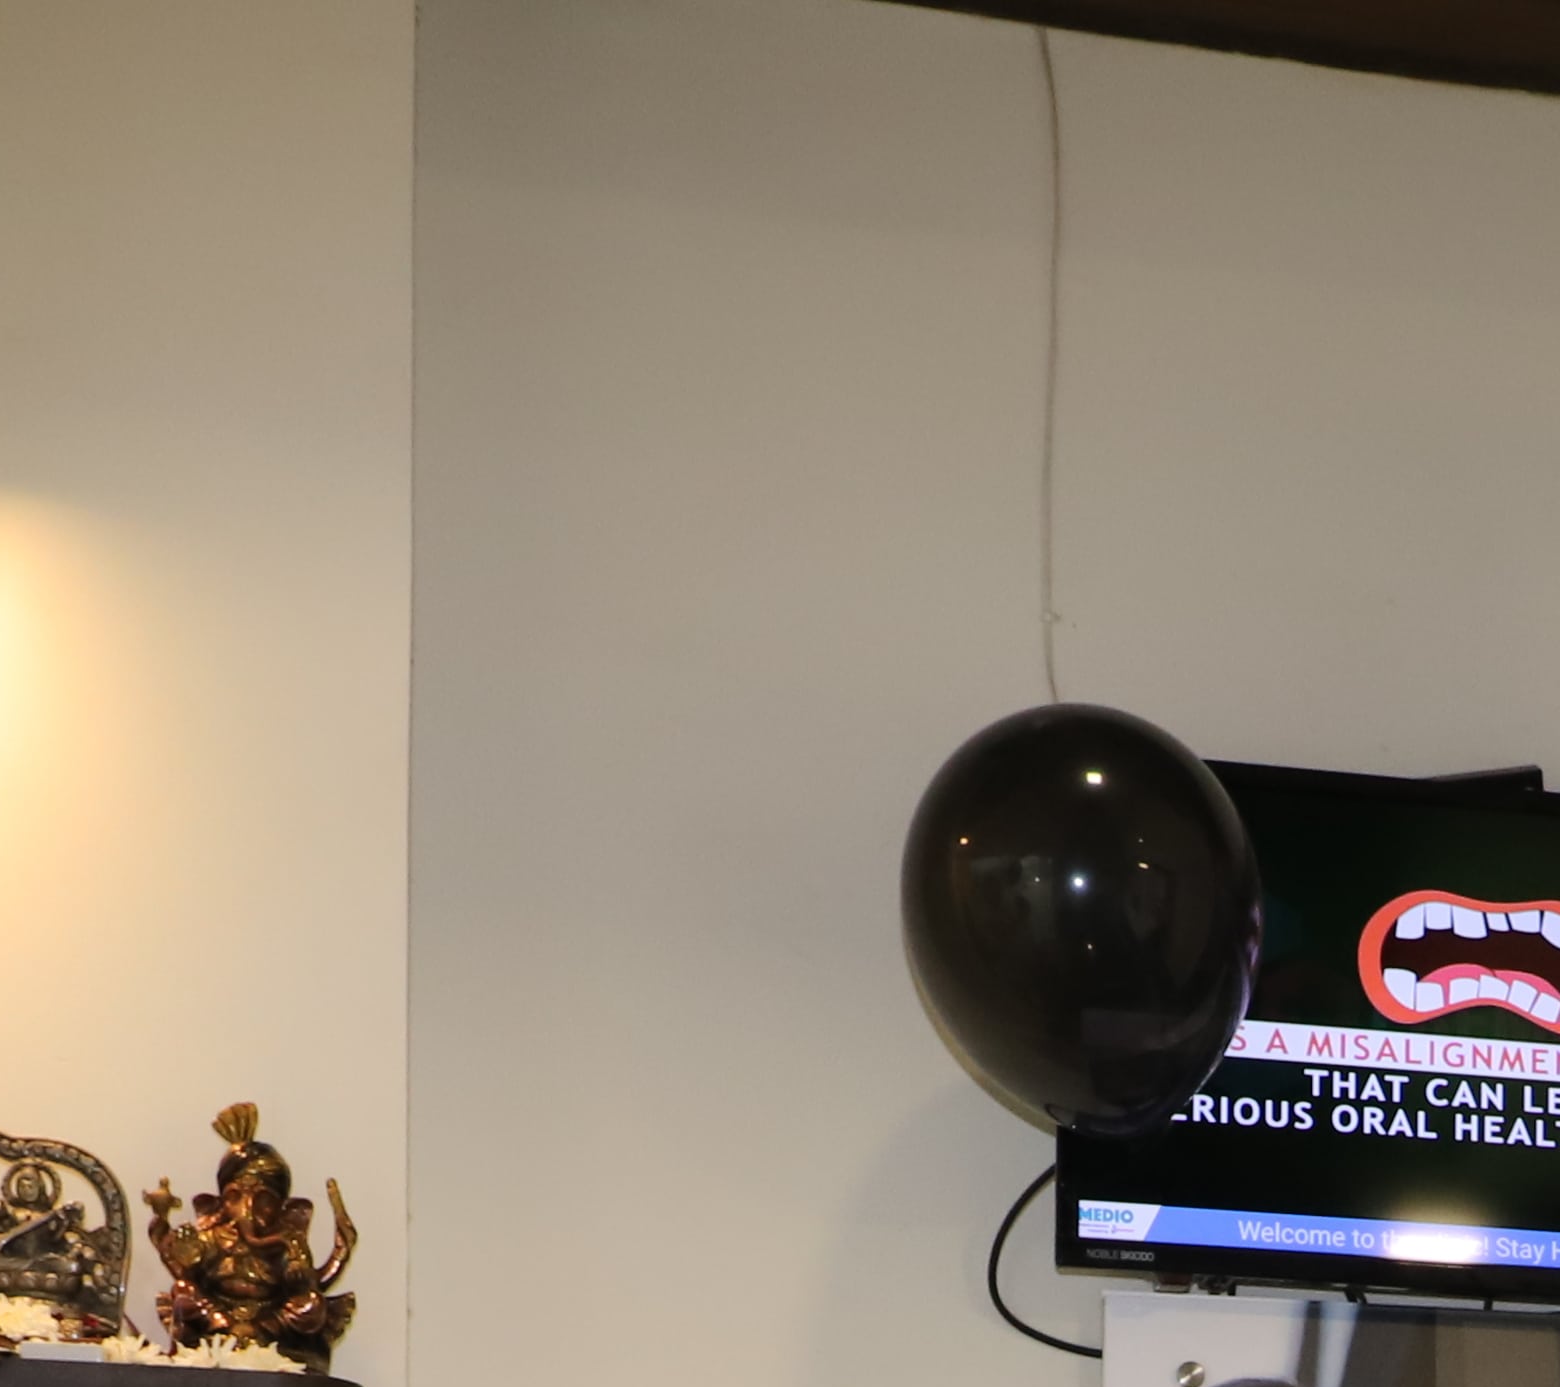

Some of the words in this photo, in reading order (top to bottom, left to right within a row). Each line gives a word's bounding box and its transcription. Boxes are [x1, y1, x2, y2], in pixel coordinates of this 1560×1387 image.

[1264, 1028, 1290, 1055] A
[1303, 1068, 1410, 1103] THAT
[1425, 1077, 1505, 1112] CAN
[1171, 1093, 1314, 1131] RIOUS
[1331, 1104, 1438, 1140] ORAL
[1238, 1219, 1346, 1248] Welcome
[1351, 1229, 1375, 1249] to
[1496, 1236, 1545, 1264] Stay
